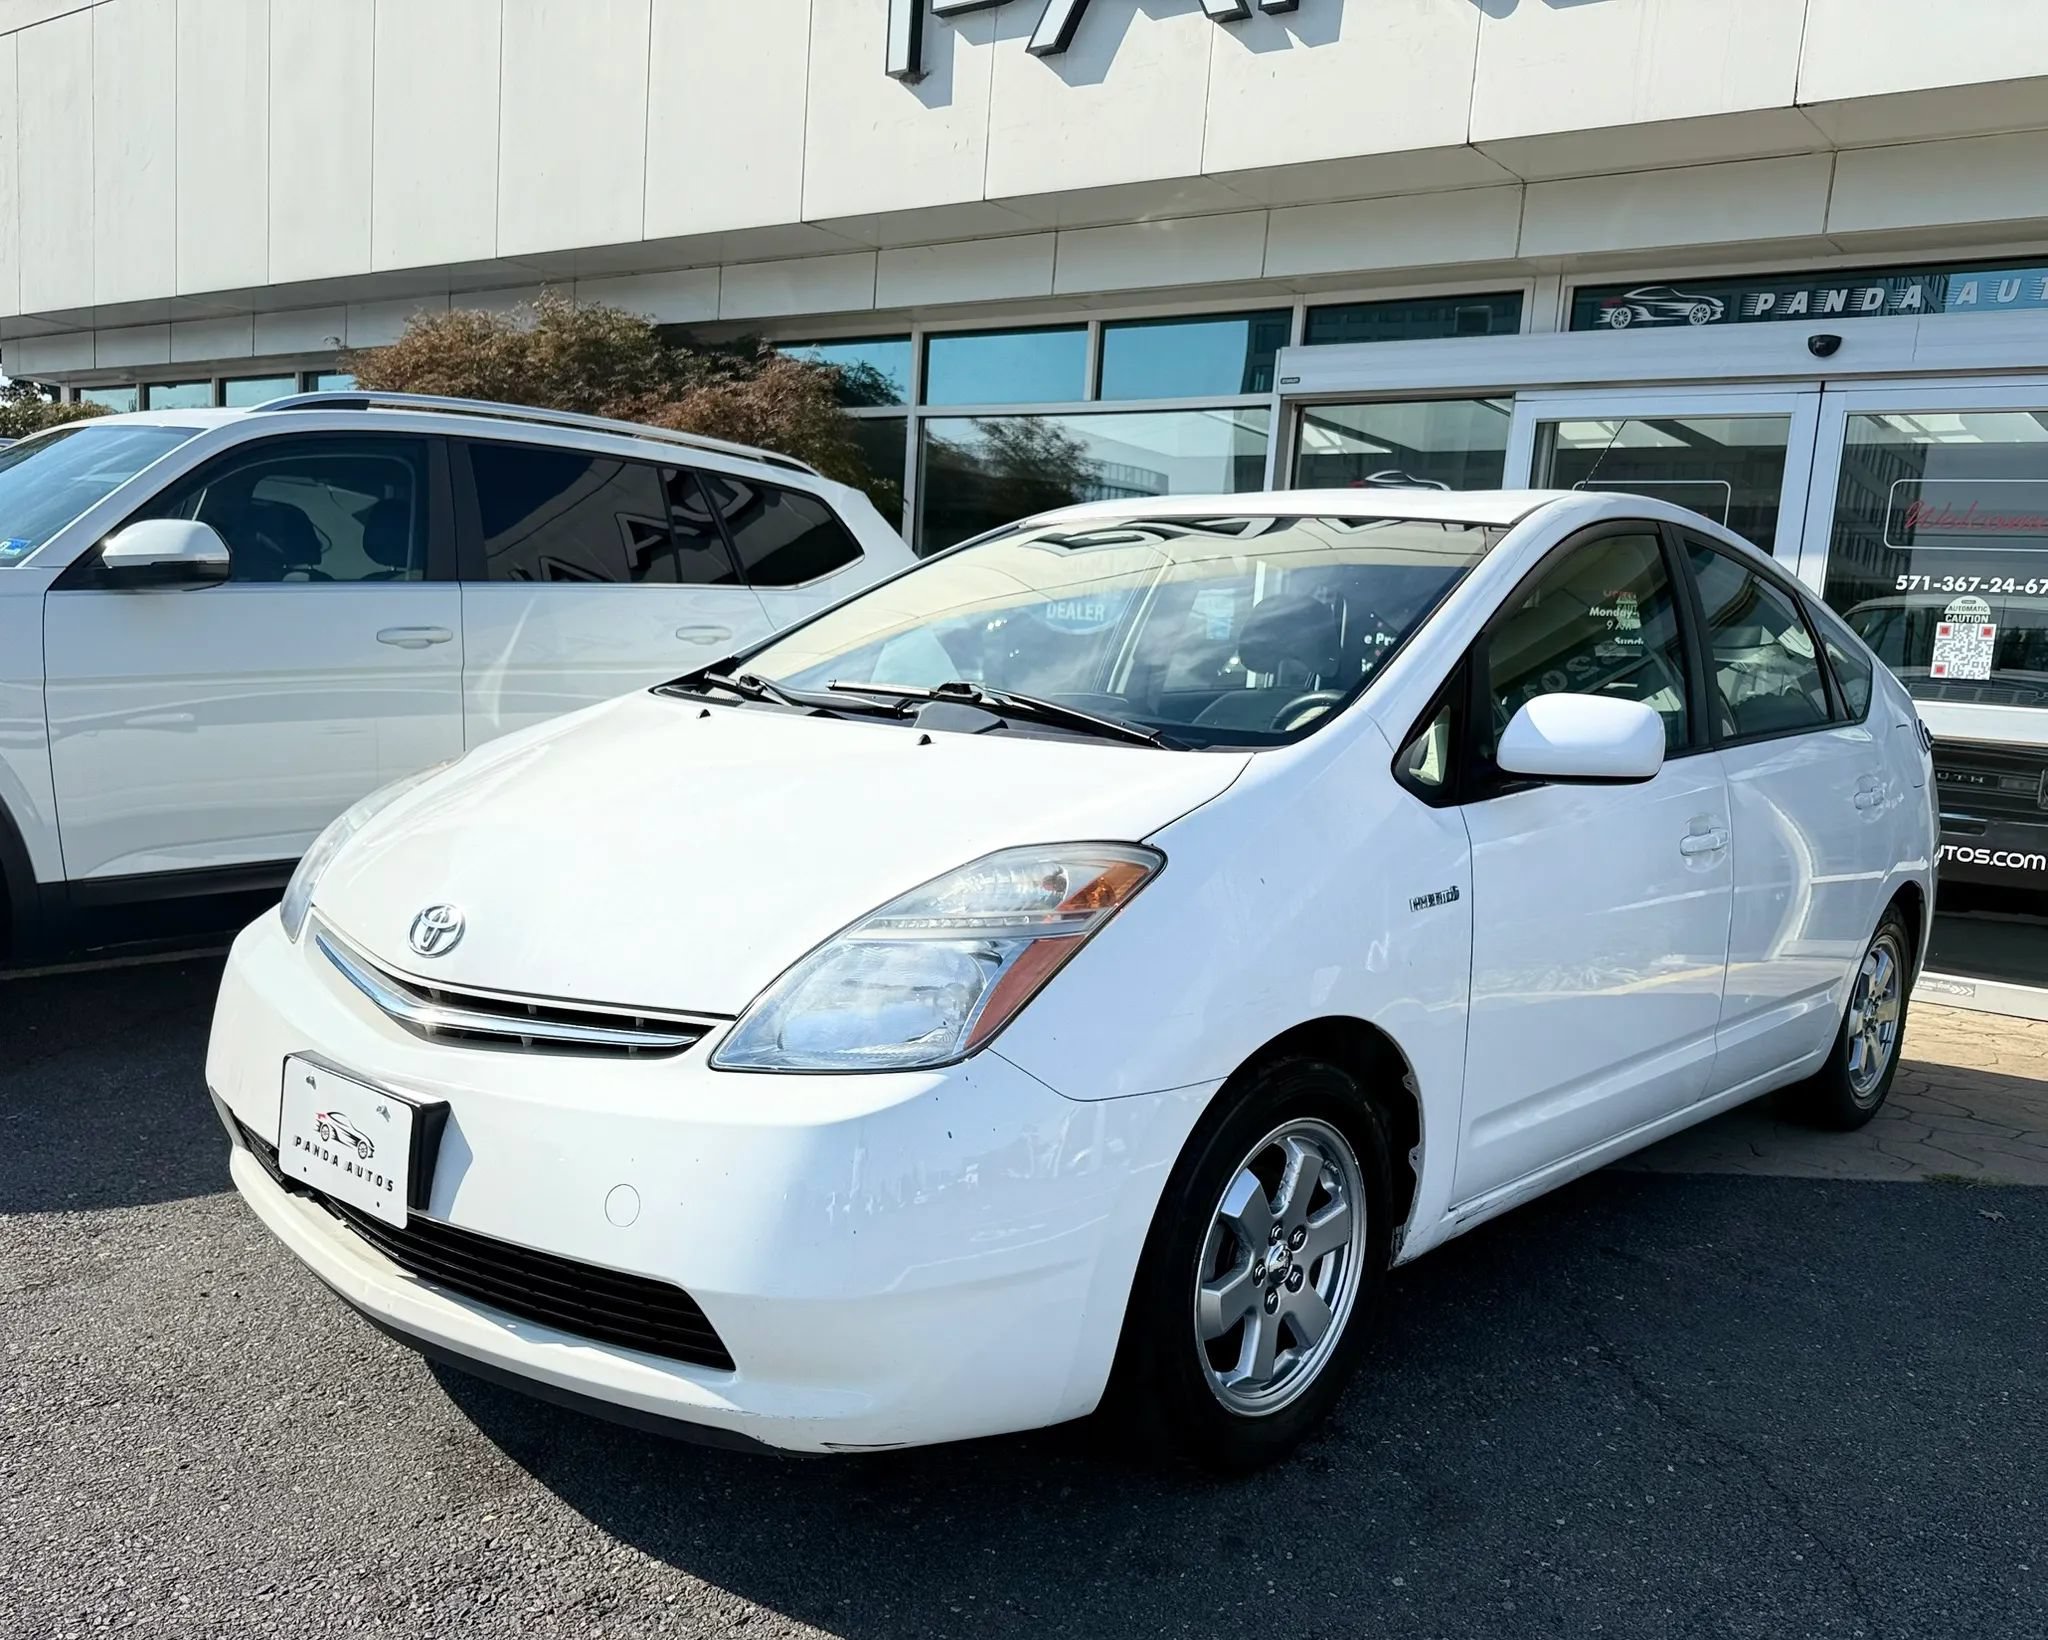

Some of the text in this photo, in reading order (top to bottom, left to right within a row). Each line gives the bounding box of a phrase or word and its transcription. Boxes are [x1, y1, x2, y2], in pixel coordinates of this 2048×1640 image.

[1743, 284, 1922, 316] PANDA
[1045, 601, 1105, 622] DEALER
[1945, 614, 1989, 624] CAUTION
[1947, 604, 1988, 613] AUTOMATIC
[294, 1135, 394, 1192] PANDA AUTOS
